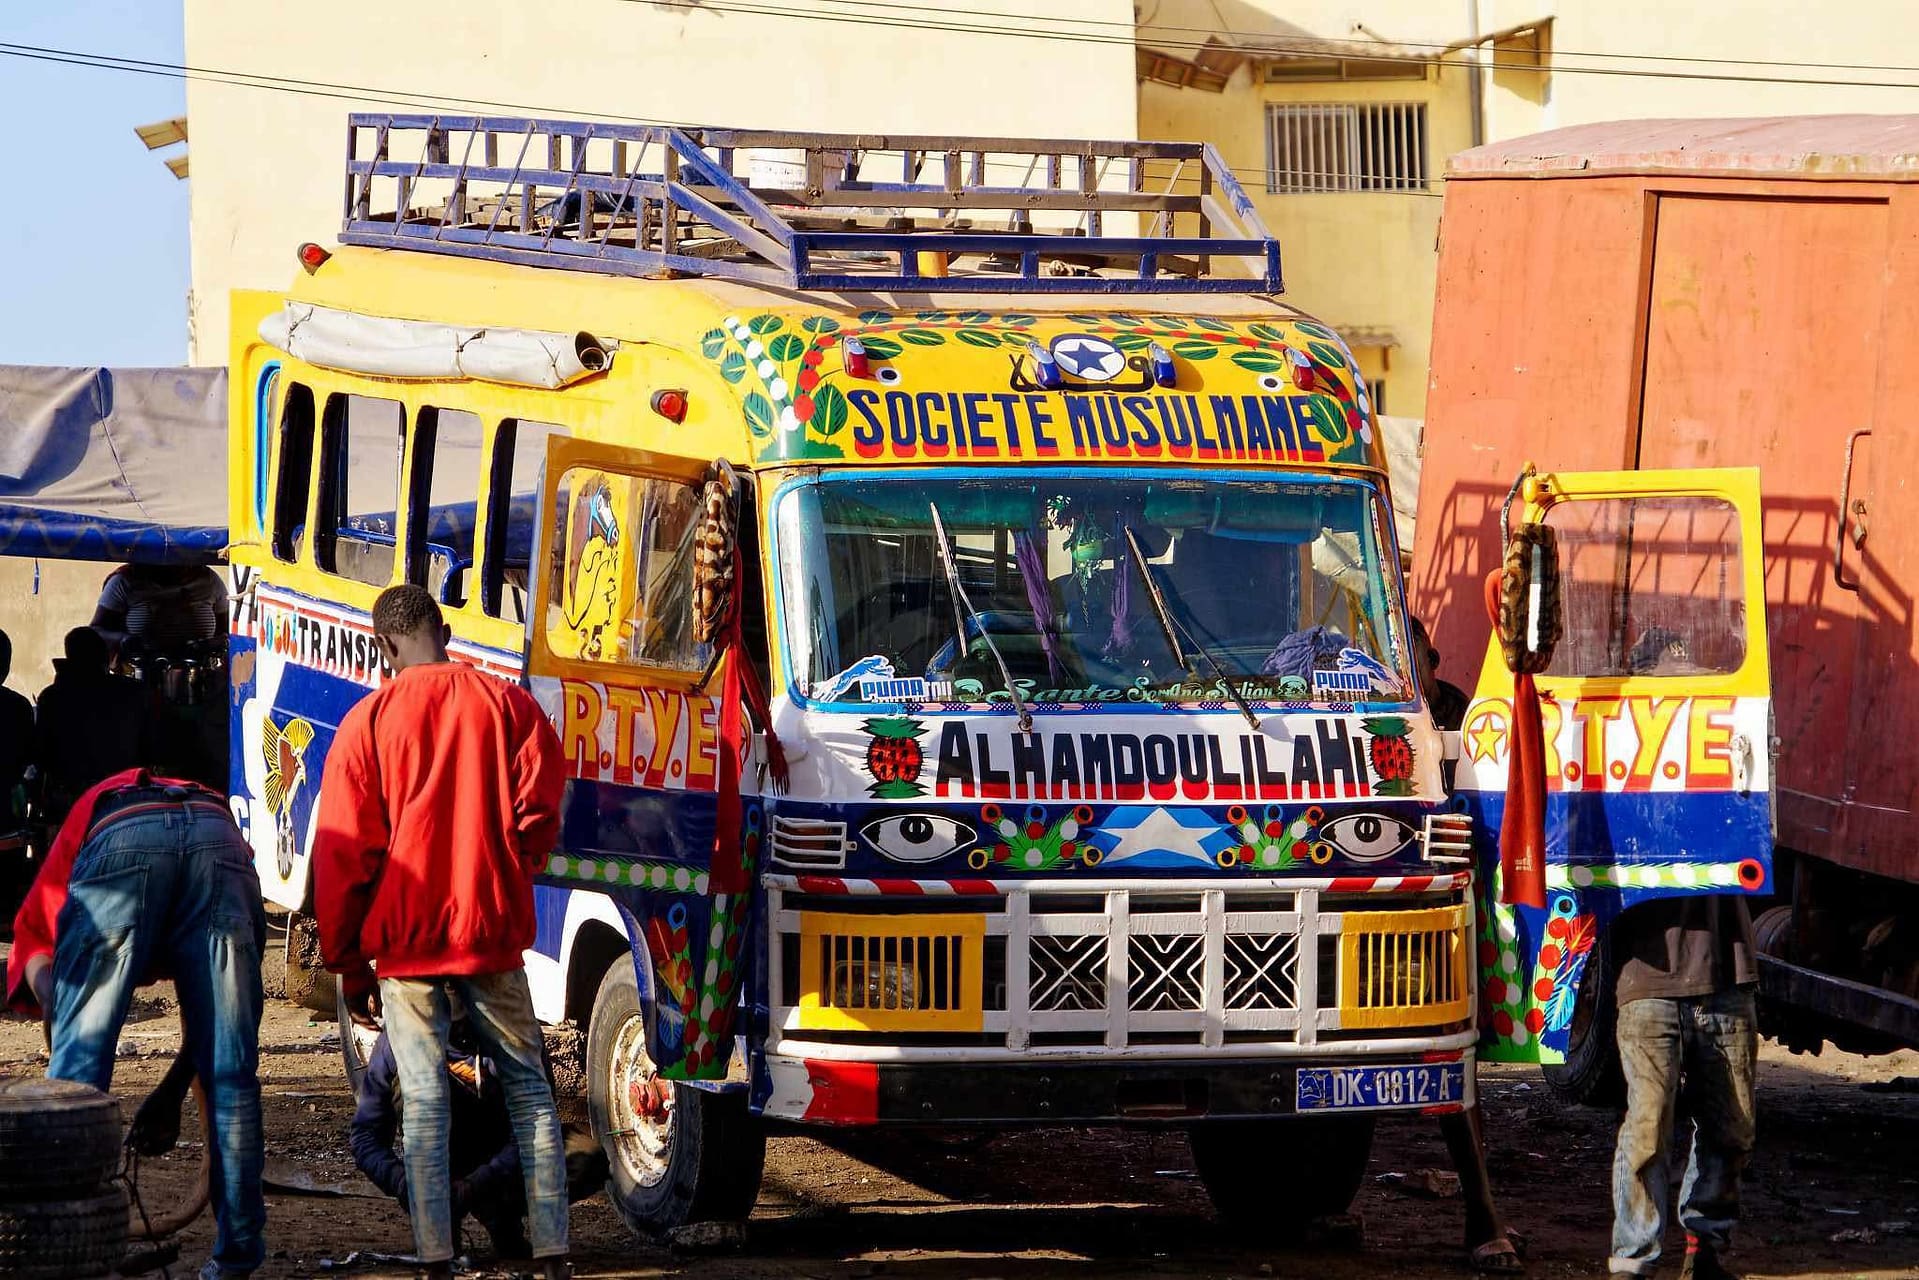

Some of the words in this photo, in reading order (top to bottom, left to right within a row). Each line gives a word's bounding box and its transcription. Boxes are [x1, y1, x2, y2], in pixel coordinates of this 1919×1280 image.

[846, 388, 1060, 458] SOCIETE
[1067, 392, 1325, 462] MUSULMANE
[862, 678, 925, 698] PUMA
[1315, 672, 1370, 690] PUMA
